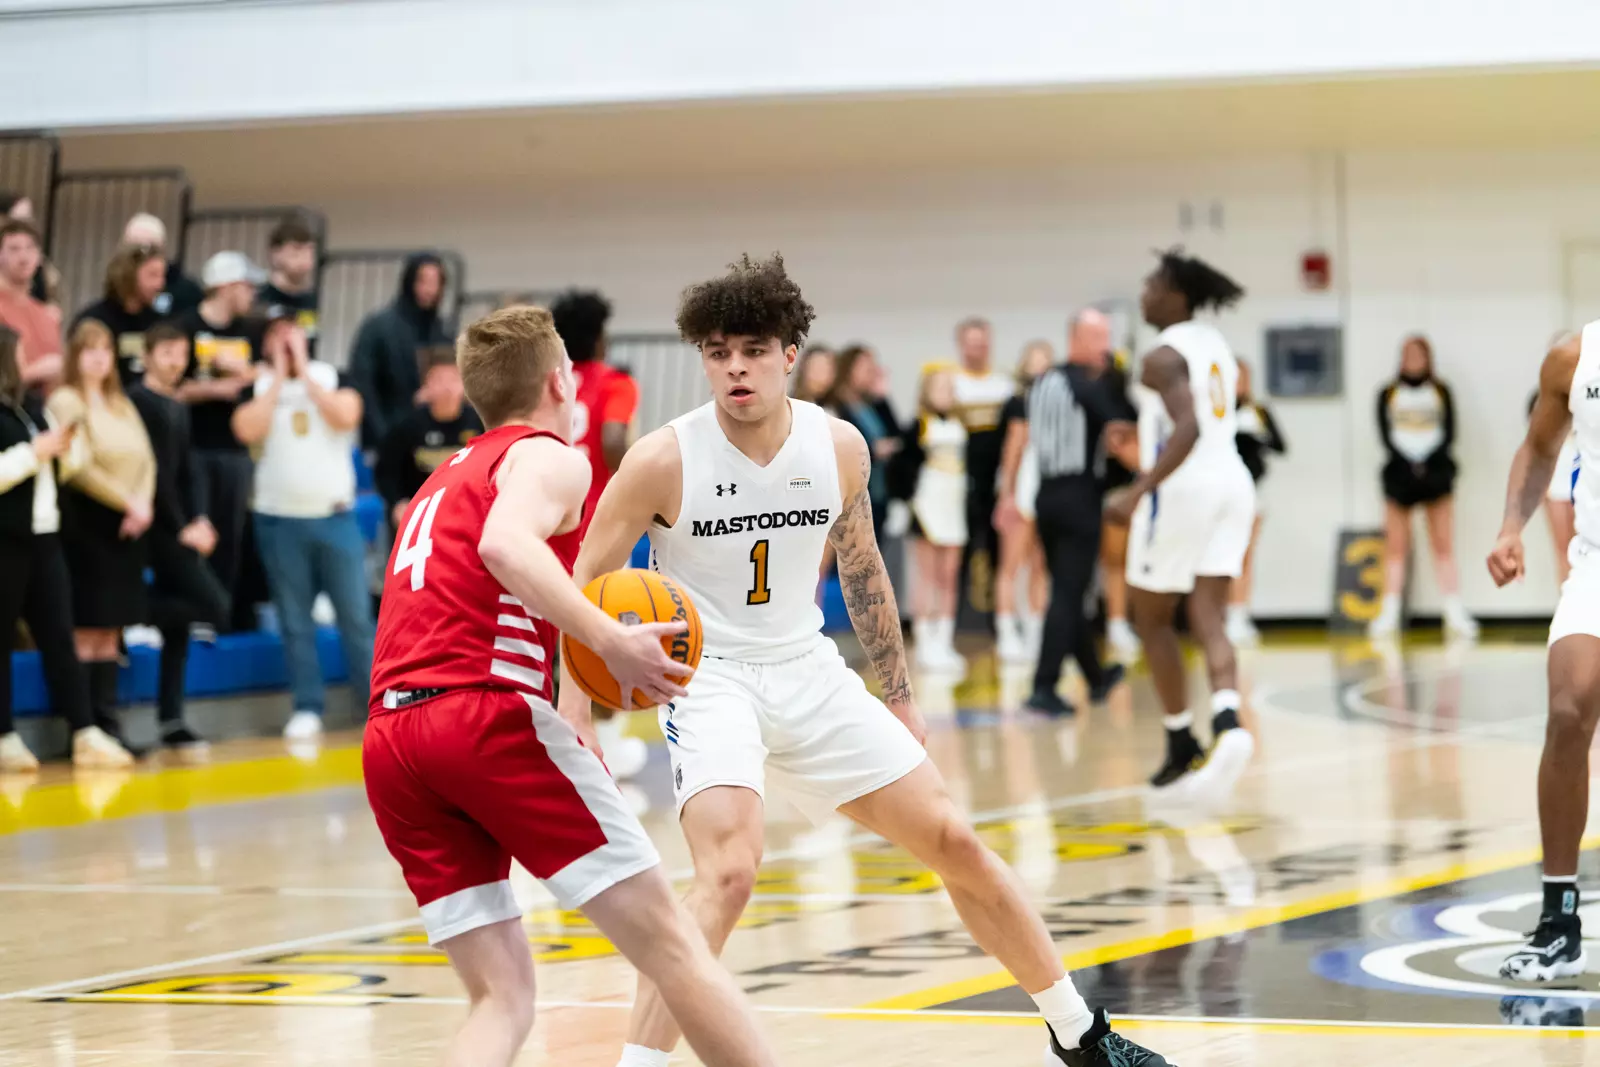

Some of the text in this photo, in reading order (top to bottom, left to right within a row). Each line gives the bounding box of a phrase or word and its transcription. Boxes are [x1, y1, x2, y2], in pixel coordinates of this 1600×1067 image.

[393, 487, 446, 592] 4
[692, 508, 830, 537] MASTODONS
[746, 539, 771, 606] 1
